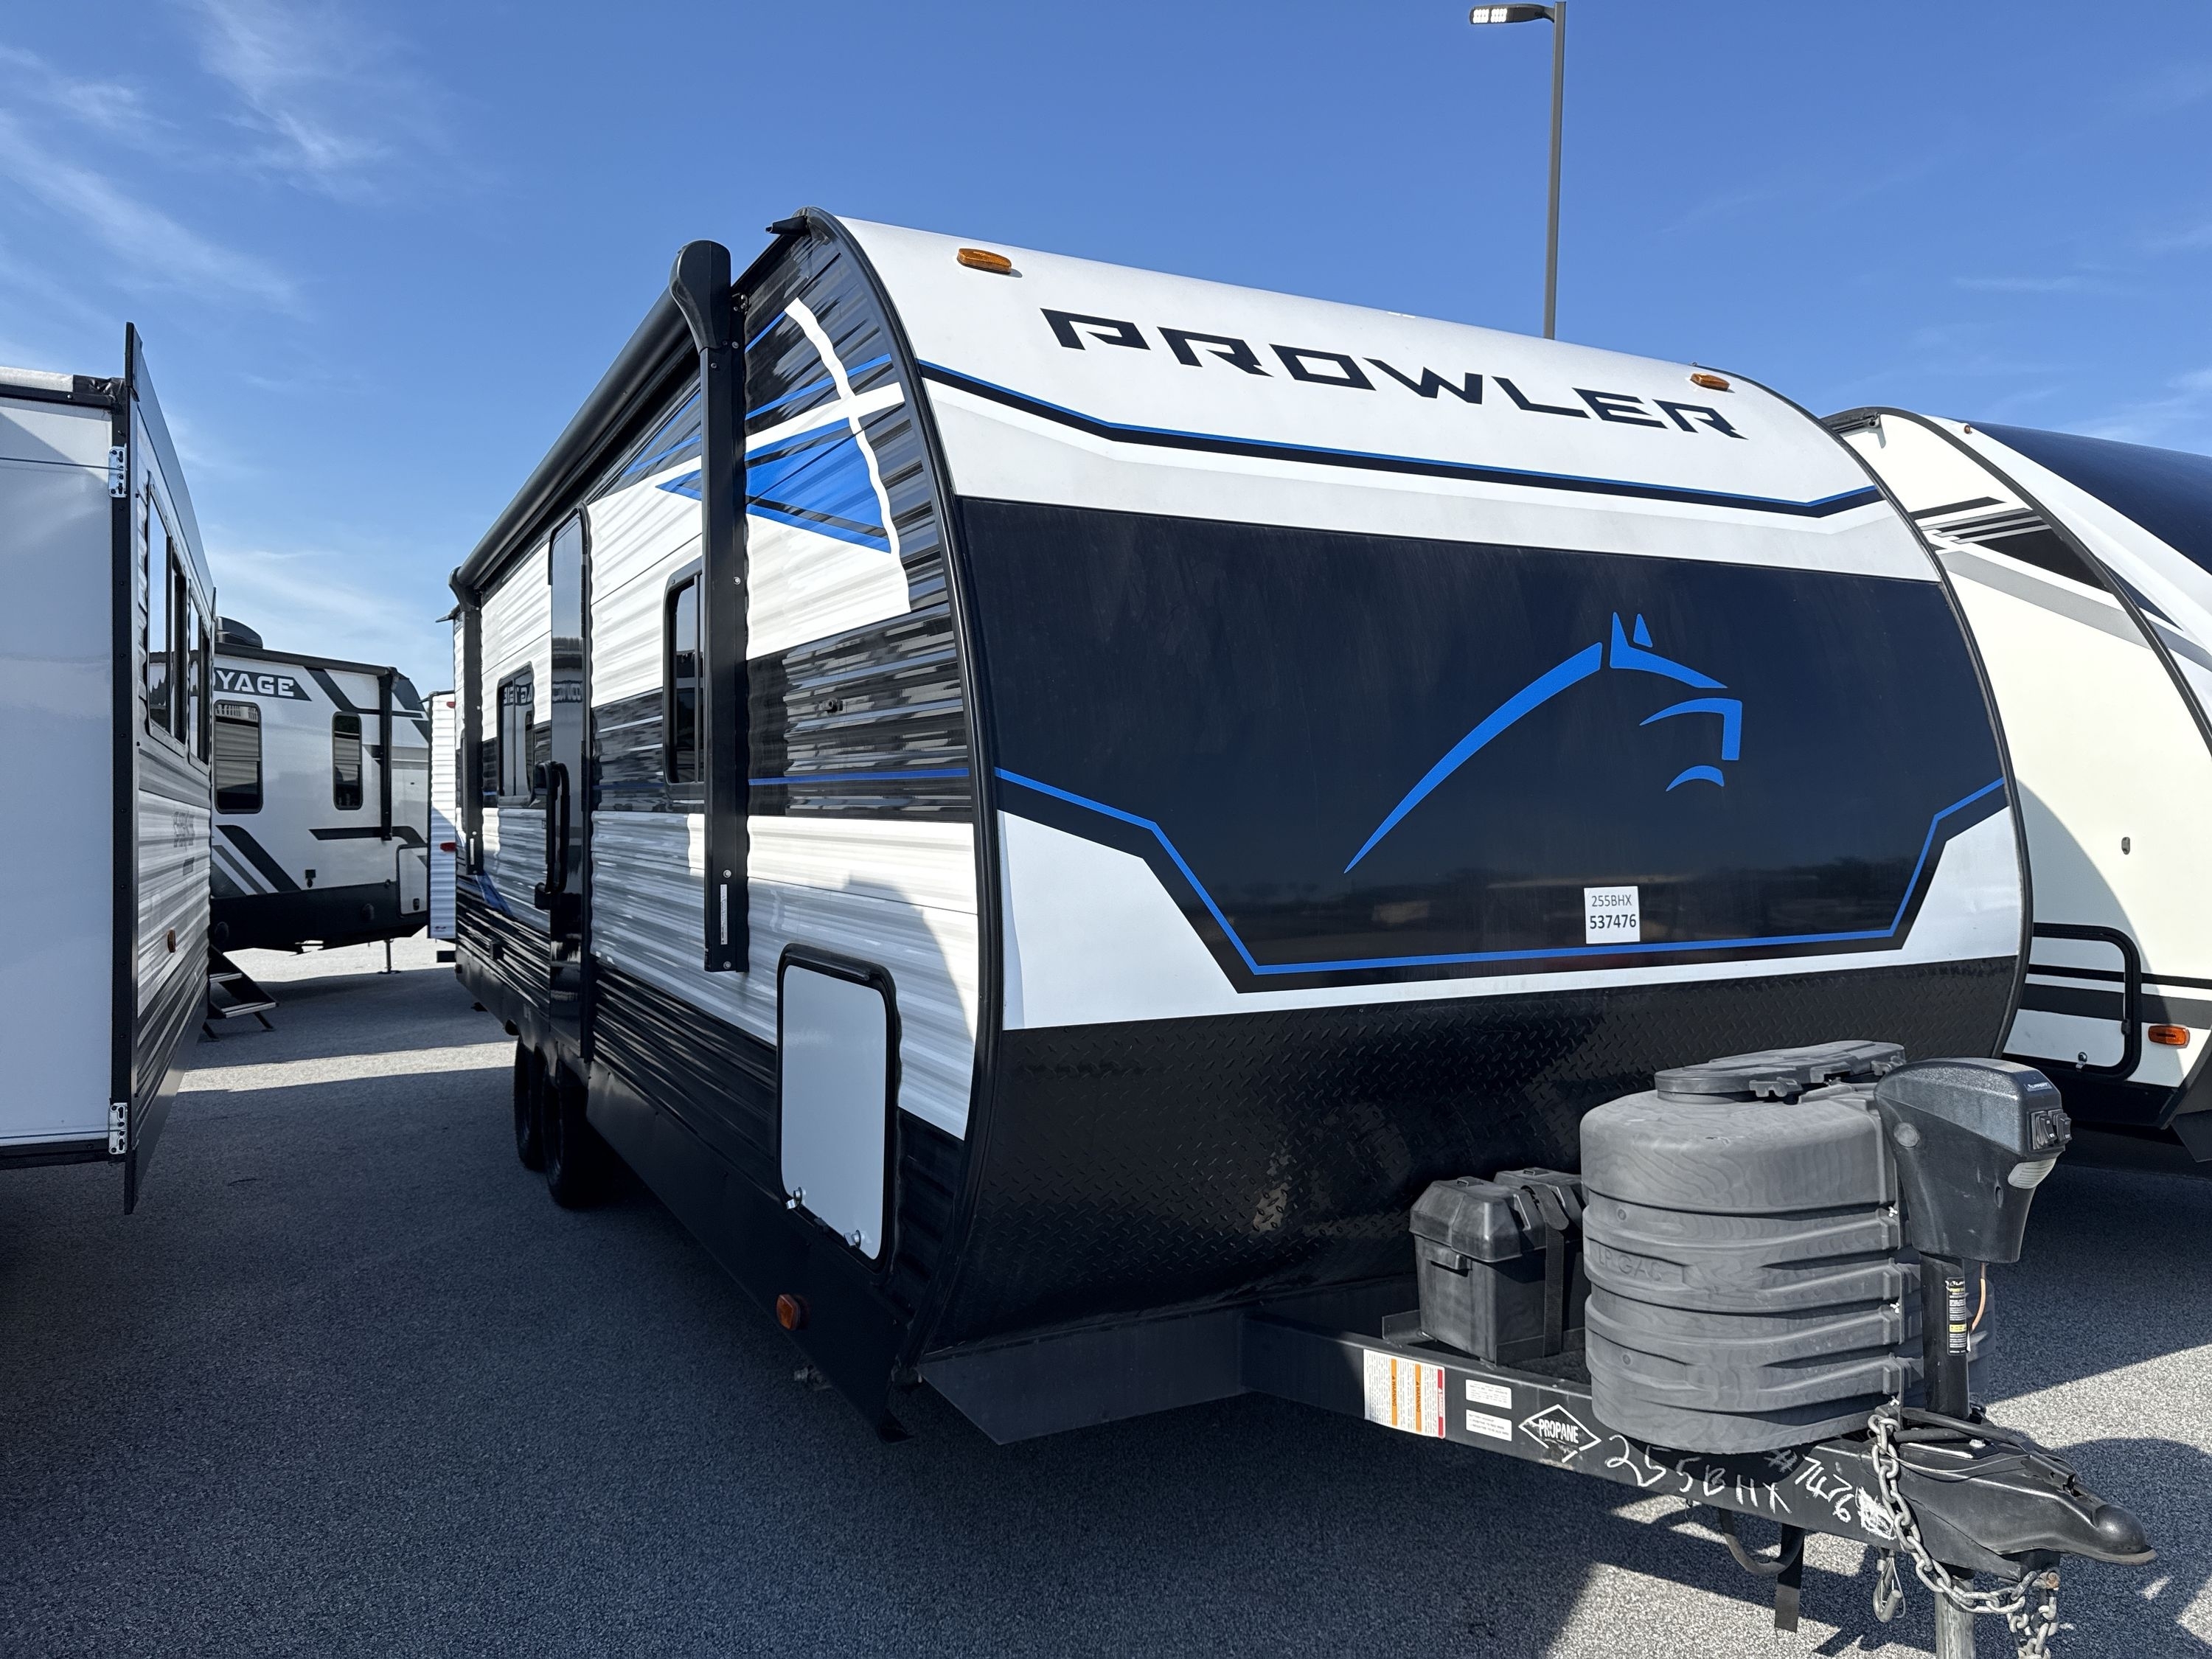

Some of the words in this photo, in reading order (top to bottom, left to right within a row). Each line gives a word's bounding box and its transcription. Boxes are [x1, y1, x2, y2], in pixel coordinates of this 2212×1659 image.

[1040, 307, 1749, 440] PROWLER
[212, 669, 295, 697] YAGE
[1591, 894, 1632, 907] 255BHX
[1590, 914, 1637, 929] 537476
[1538, 1418, 1579, 1444] PROPANE
[1604, 1434, 1792, 1514] 255BHX
